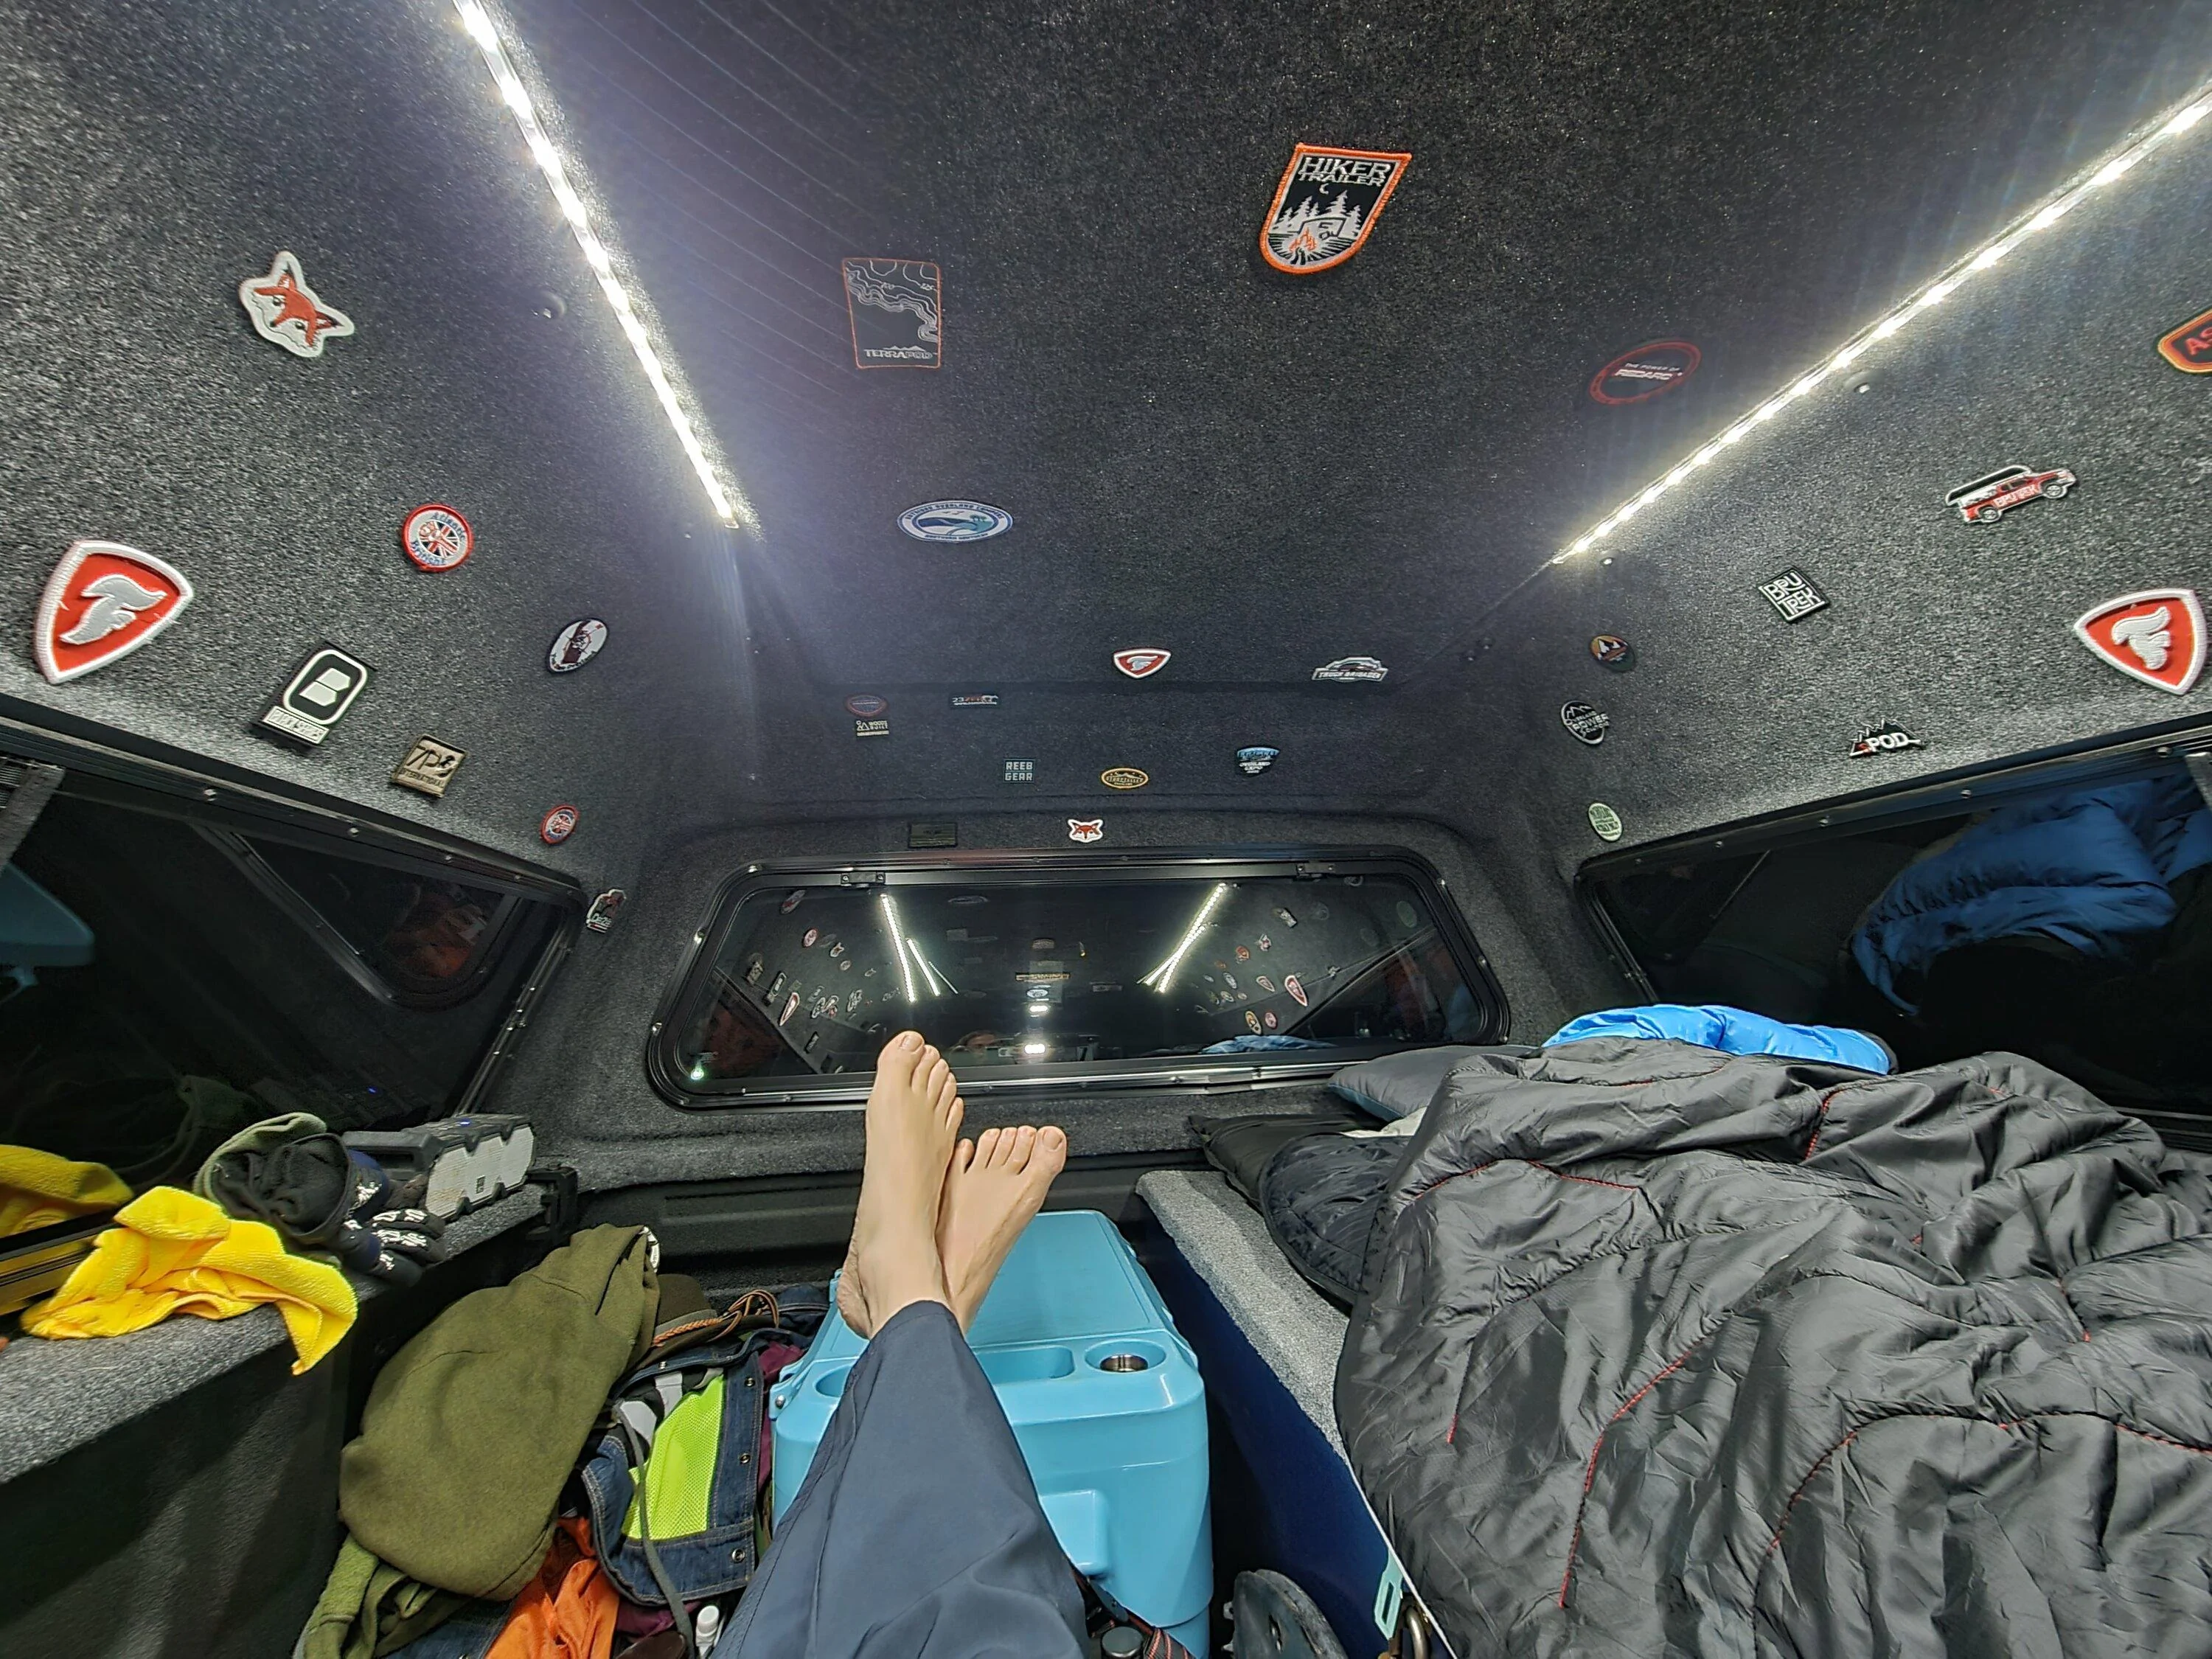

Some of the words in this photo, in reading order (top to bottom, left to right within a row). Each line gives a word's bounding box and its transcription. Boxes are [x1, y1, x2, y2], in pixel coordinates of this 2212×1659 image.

[1300, 157, 1391, 179] HIKER
[1298, 170, 1385, 187] TRAILER
[863, 349, 933, 359] TERRAPOD
[1763, 572, 1806, 601] BRU
[1777, 587, 1821, 615] TREK
[1572, 714, 1609, 731] POWER
[1006, 762, 1032, 770] REEB
[1005, 773, 1032, 781] GEAR
